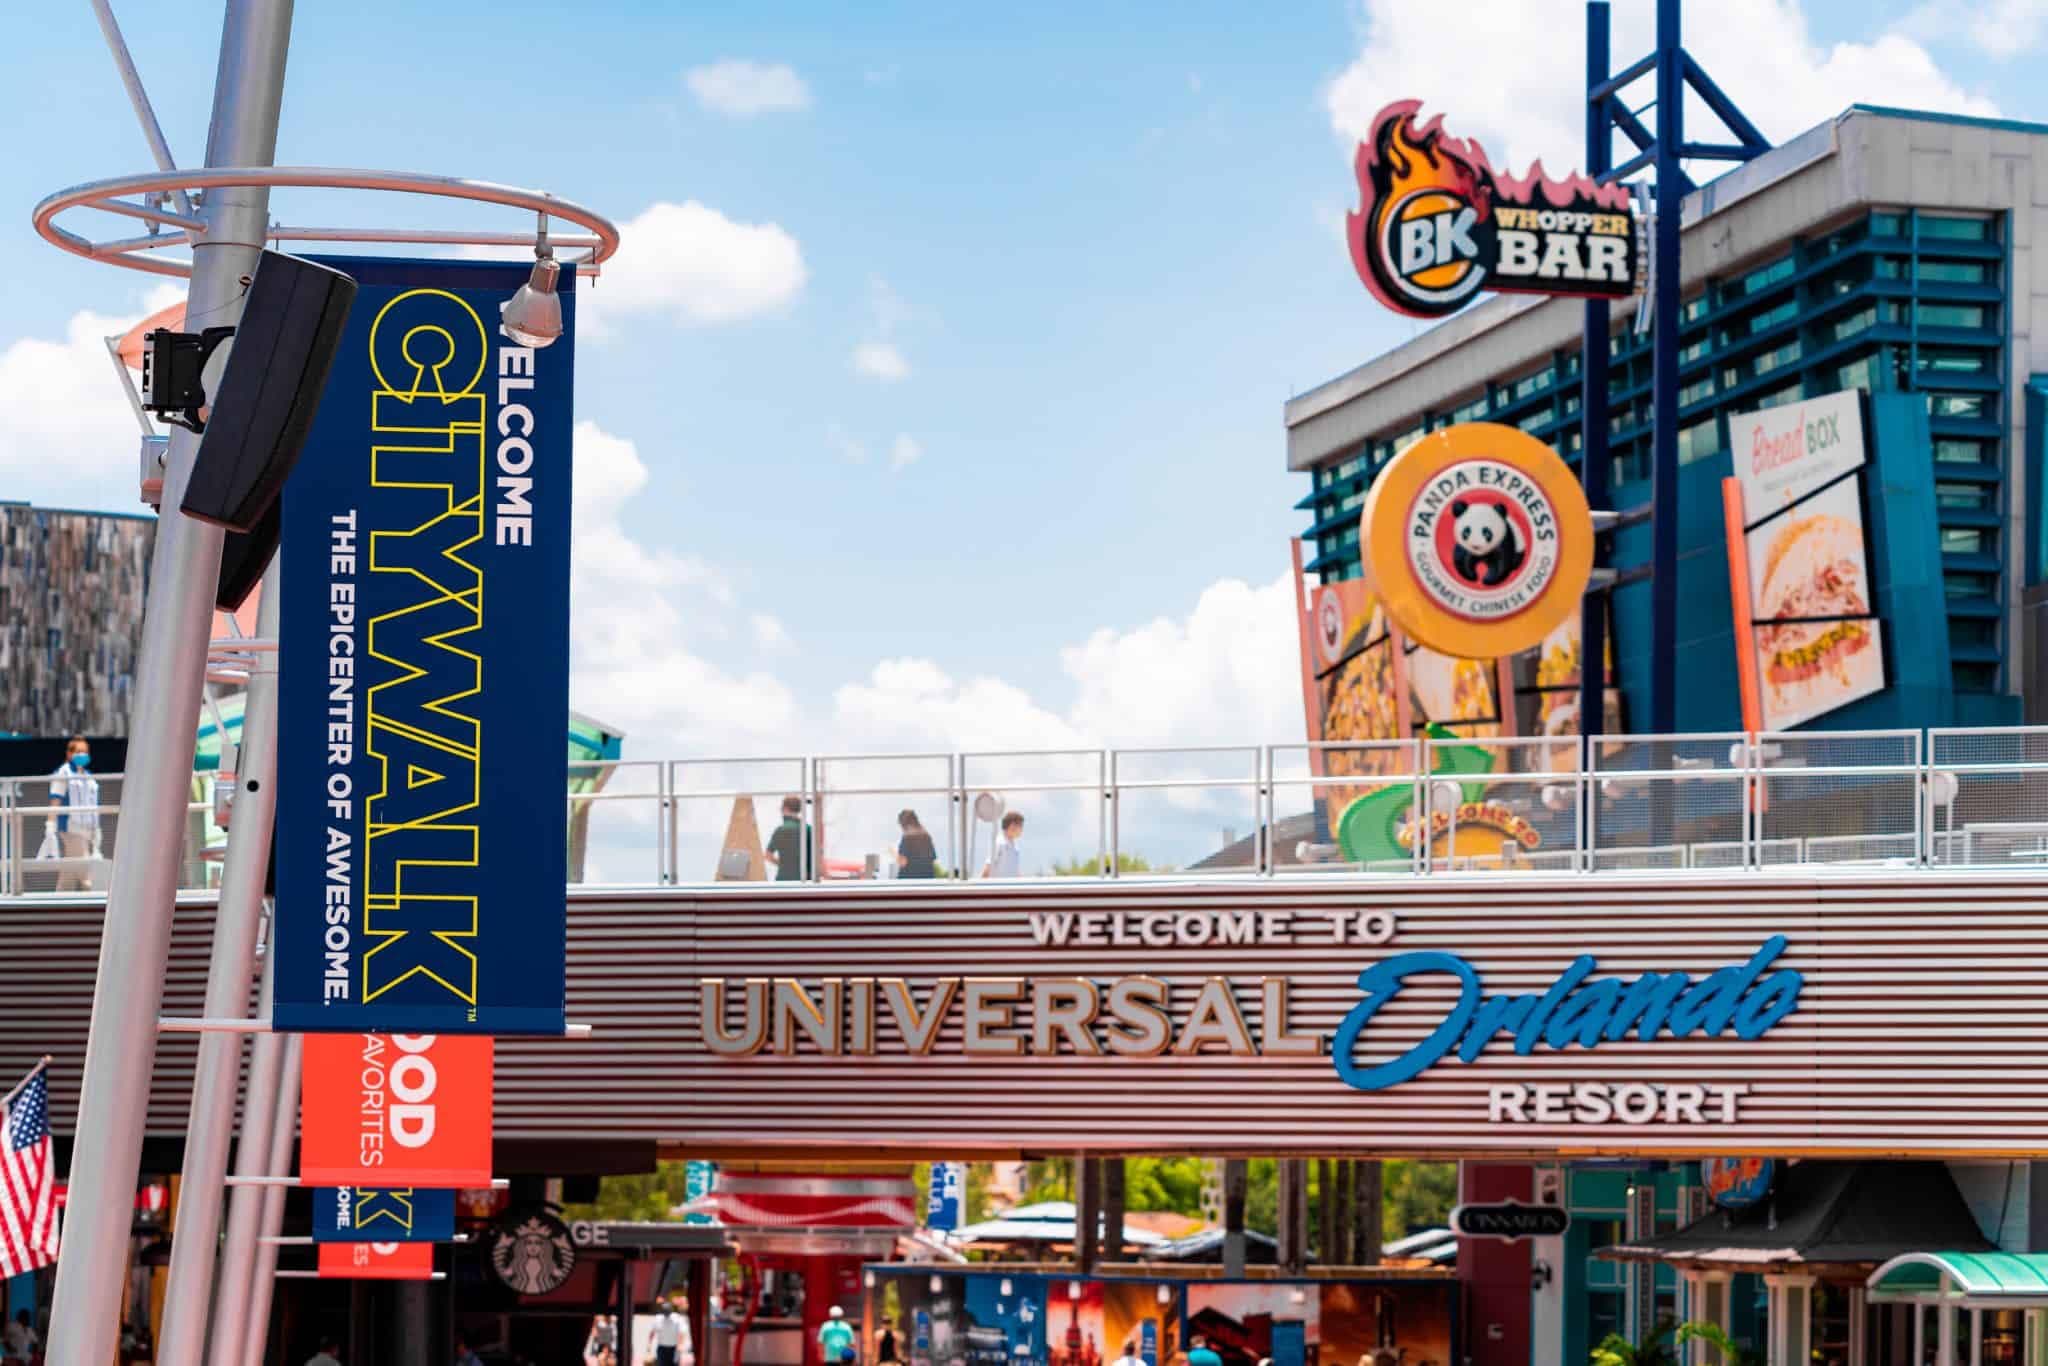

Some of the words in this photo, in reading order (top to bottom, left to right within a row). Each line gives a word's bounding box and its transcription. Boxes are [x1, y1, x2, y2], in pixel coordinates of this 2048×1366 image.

[1401, 207, 1479, 276] BK
[1494, 207, 1629, 235] WHOPPER
[1496, 230, 1630, 282] BAR
[495, 300, 535, 546] ELCOME
[1414, 471, 1472, 538] PANDA
[1479, 467, 1554, 542] EXPRESS
[330, 509, 357, 575] THE
[1416, 551, 1466, 608] GOURMET
[1471, 593, 1528, 614] CHINESE
[1527, 555, 1552, 593] FOOD
[327, 582, 355, 766] EPICENTER
[363, 288, 487, 1005] CITYWALK
[326, 773, 352, 820] OF
[323, 826, 352, 1007] AWESOME.
[1028, 910, 1293, 946] WELCOME
[1328, 909, 1396, 945] TO
[699, 974, 1324, 1057] UNIVERSAL
[1332, 935, 1804, 1090] Orlando
[1488, 1083, 1750, 1125] RESORT
